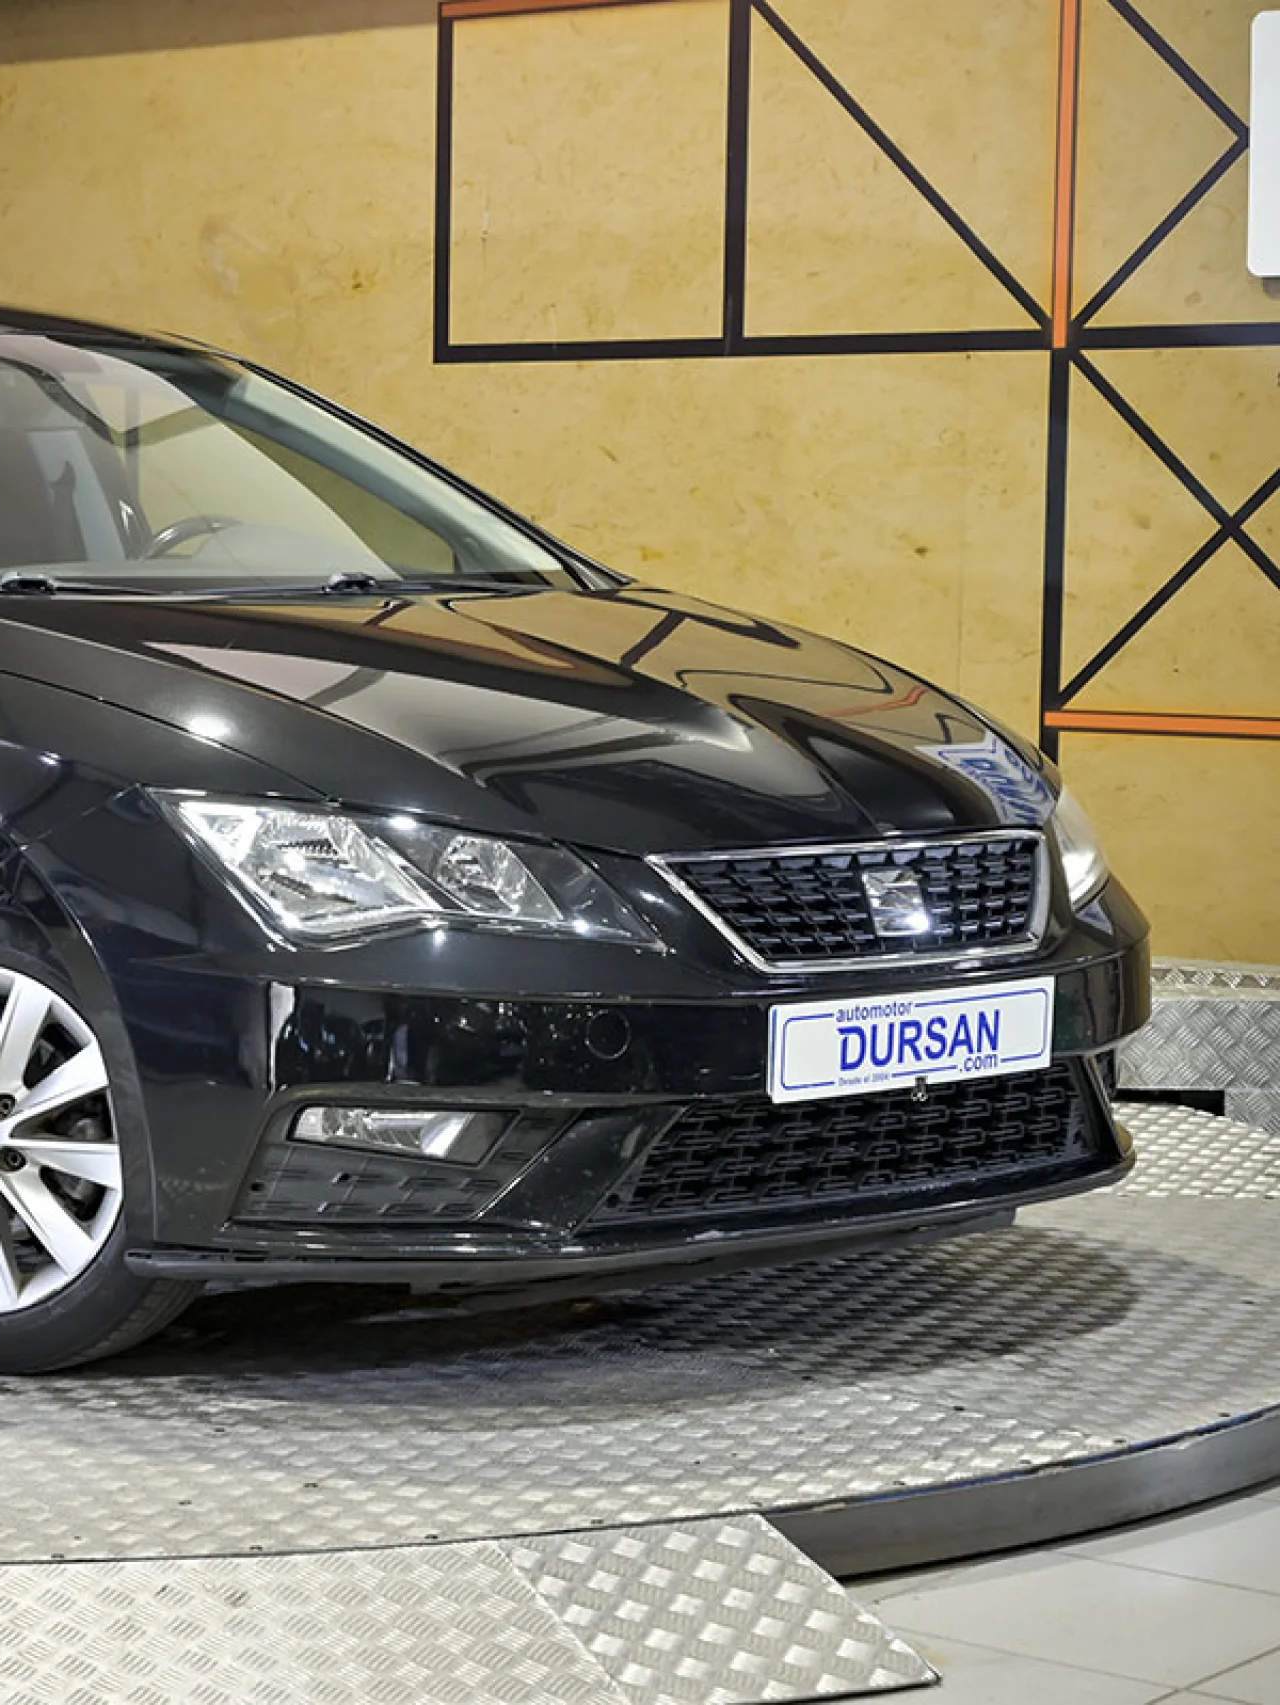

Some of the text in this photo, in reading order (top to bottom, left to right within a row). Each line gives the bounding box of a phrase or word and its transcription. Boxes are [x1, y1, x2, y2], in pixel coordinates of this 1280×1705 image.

[835, 1001, 914, 1023] automotor
[836, 1008, 1001, 1071] DURSAN
[959, 1053, 999, 1073] .com
